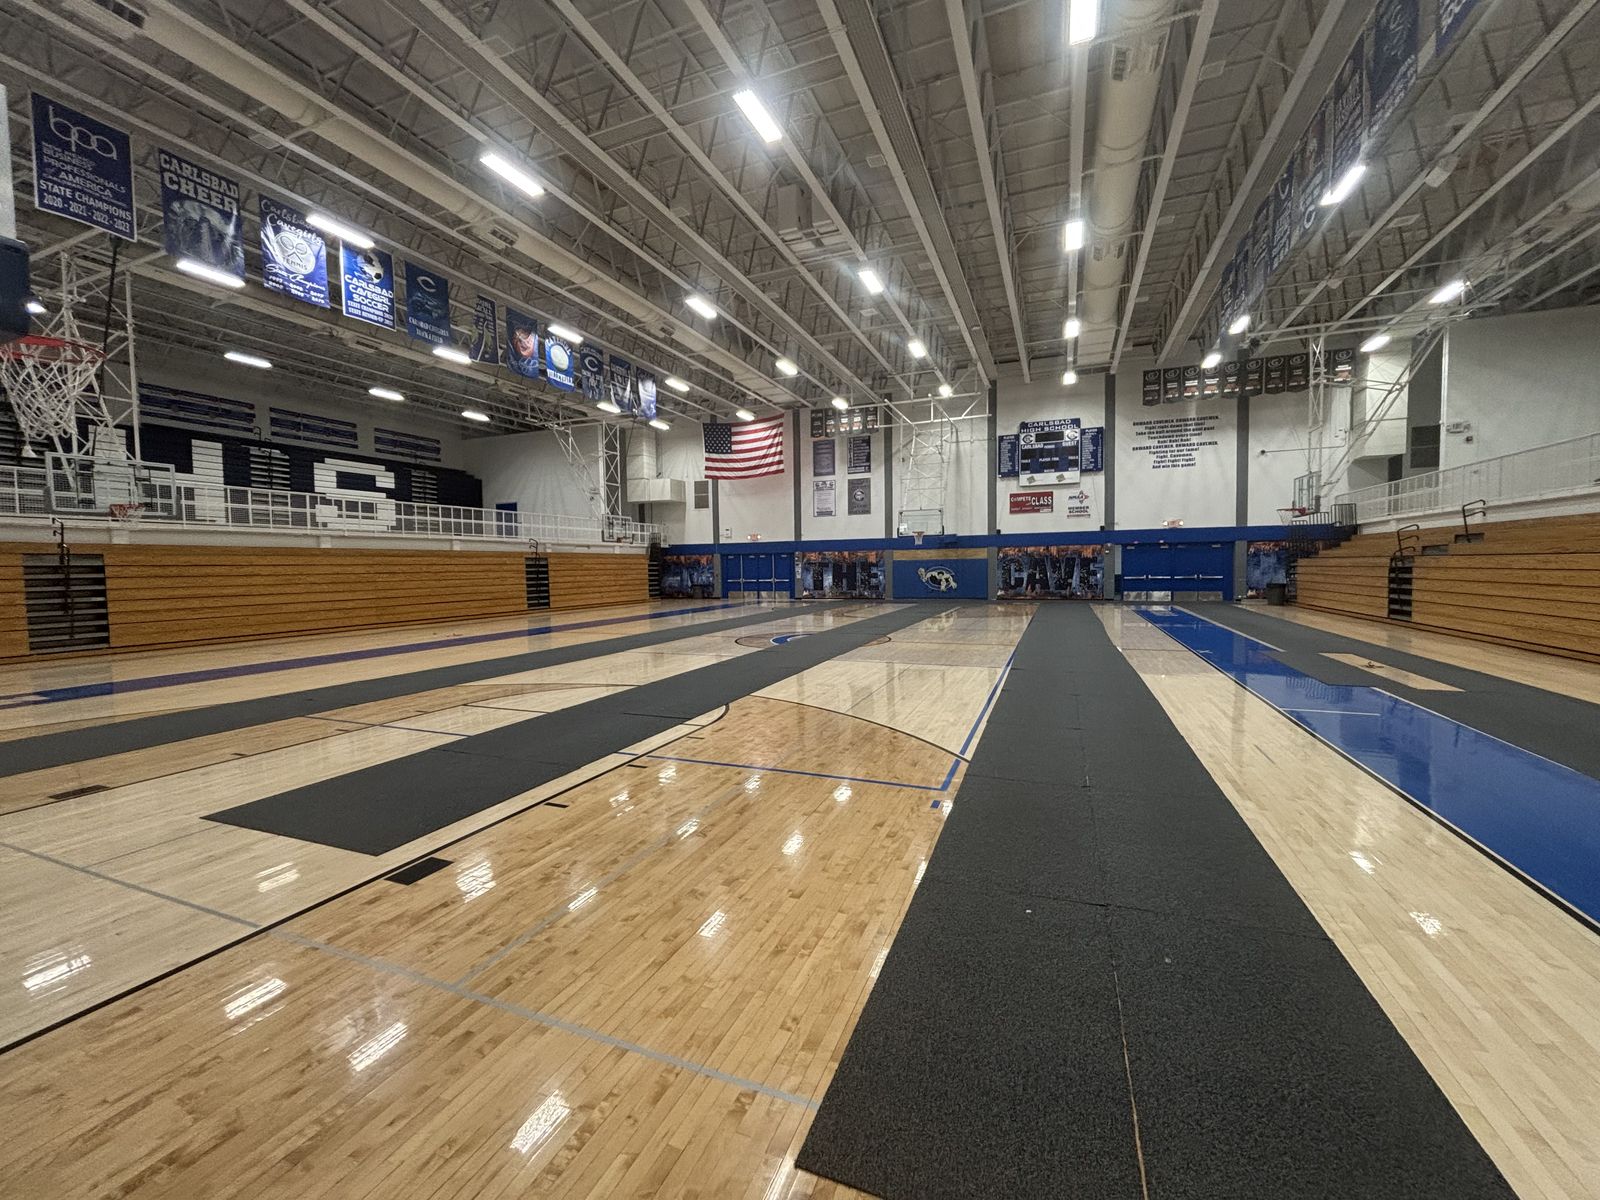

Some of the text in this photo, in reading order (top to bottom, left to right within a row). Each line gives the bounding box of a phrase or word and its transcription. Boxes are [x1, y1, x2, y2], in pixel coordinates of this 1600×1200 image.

[49, 105, 118, 160] bpa
[42, 147, 94, 171] BUSINESS
[44, 156, 126, 194] PROFESSIONALS
[59, 172, 113, 198] AMERICA
[160, 154, 239, 199] CARLSBAD
[40, 180, 132, 221] STATE CHAMPIONS
[163, 172, 238, 216] CHEER
[43, 193, 63, 208] 2020
[69, 200, 87, 217] 2021
[93, 210, 109, 225] 2022
[114, 217, 130, 233] 2023
[267, 214, 325, 245] Cavegirls
[283, 256, 308, 271] TENNIS
[345, 274, 394, 299] CARLSBAD
[349, 285, 391, 306] CAVEGIRL
[352, 294, 389, 313] SOCCER
[1028, 420, 1072, 428] CARLSBAD
[1031, 497, 1052, 506] CLASS
[803, 556, 1104, 592] THE CAVE
